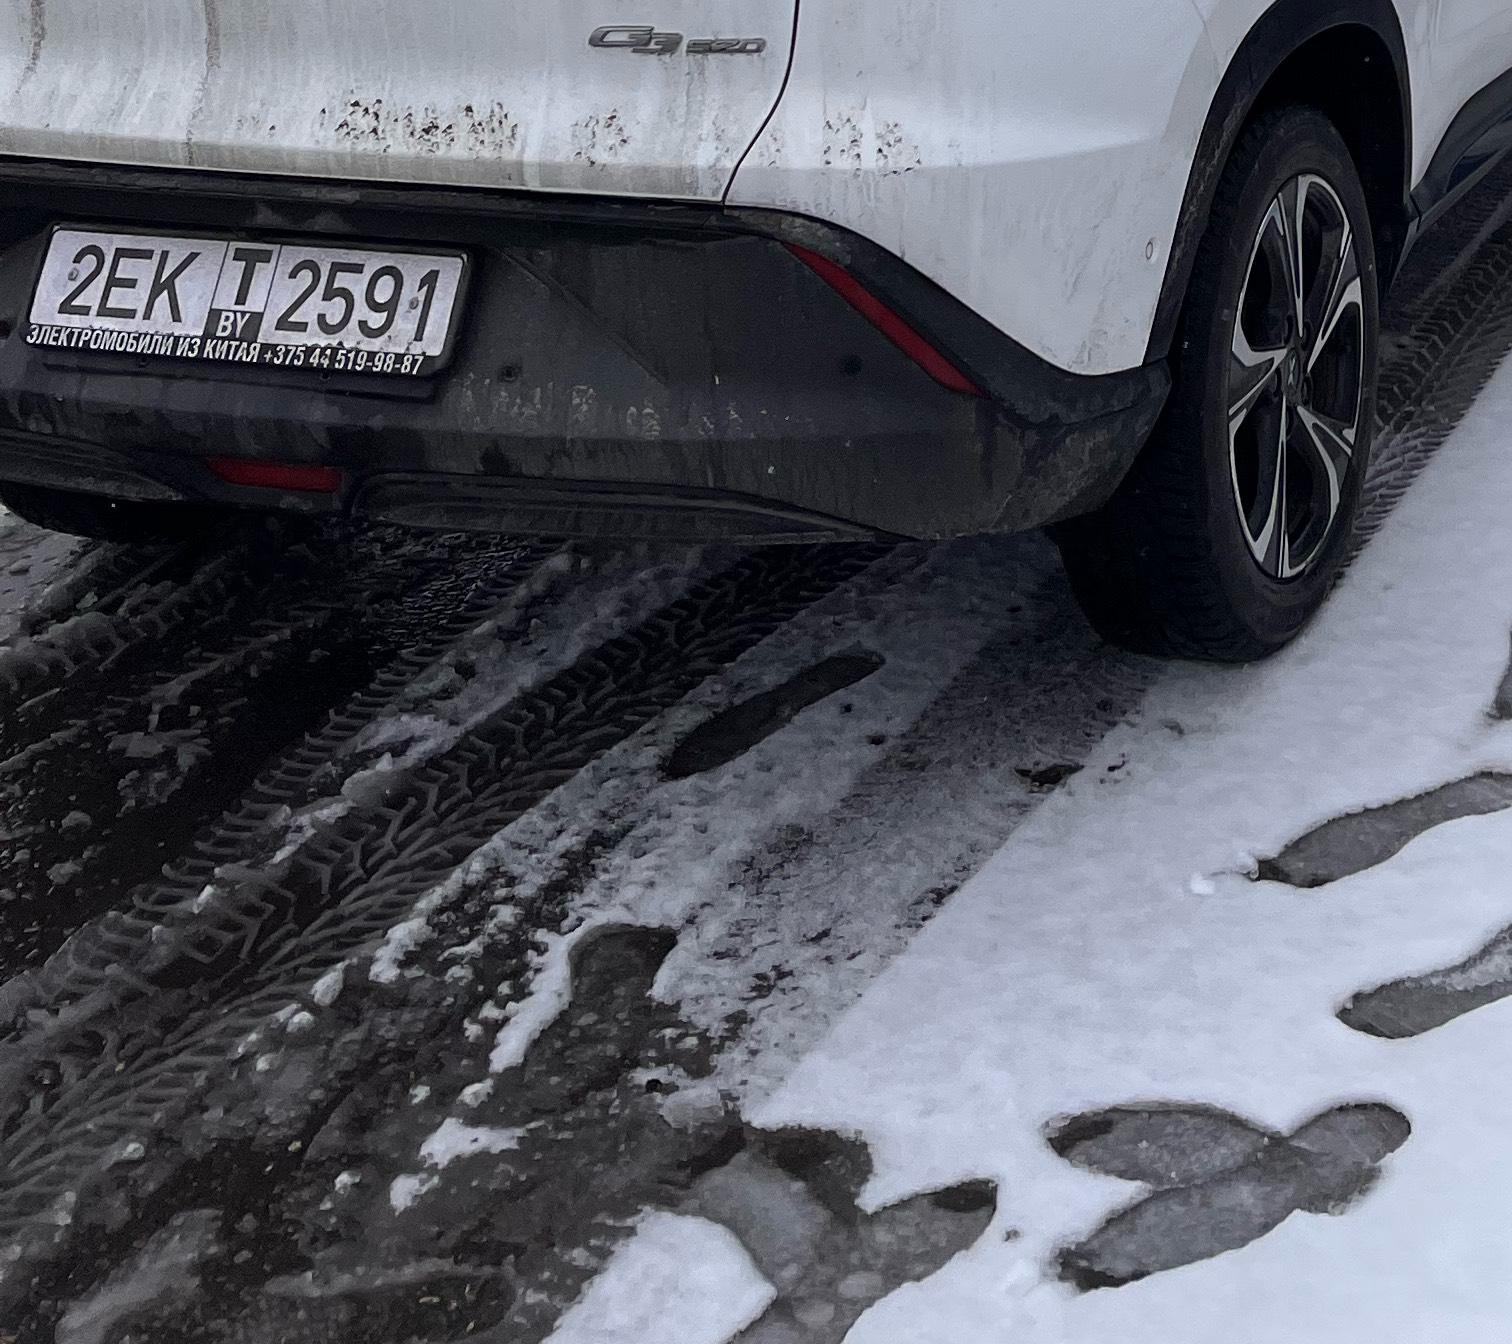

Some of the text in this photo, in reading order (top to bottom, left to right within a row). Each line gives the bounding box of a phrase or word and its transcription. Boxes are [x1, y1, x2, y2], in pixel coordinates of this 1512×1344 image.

[216, 311, 251, 338] BY
[275, 259, 440, 342] 2591
[26, 324, 174, 356] ЭЛЕКТРОМОБИЛИ
[176, 335, 200, 358] ИЗ
[203, 338, 260, 362] КИТАЯ
[264, 345, 306, 367] +375
[335, 350, 424, 375] 519-98-87
